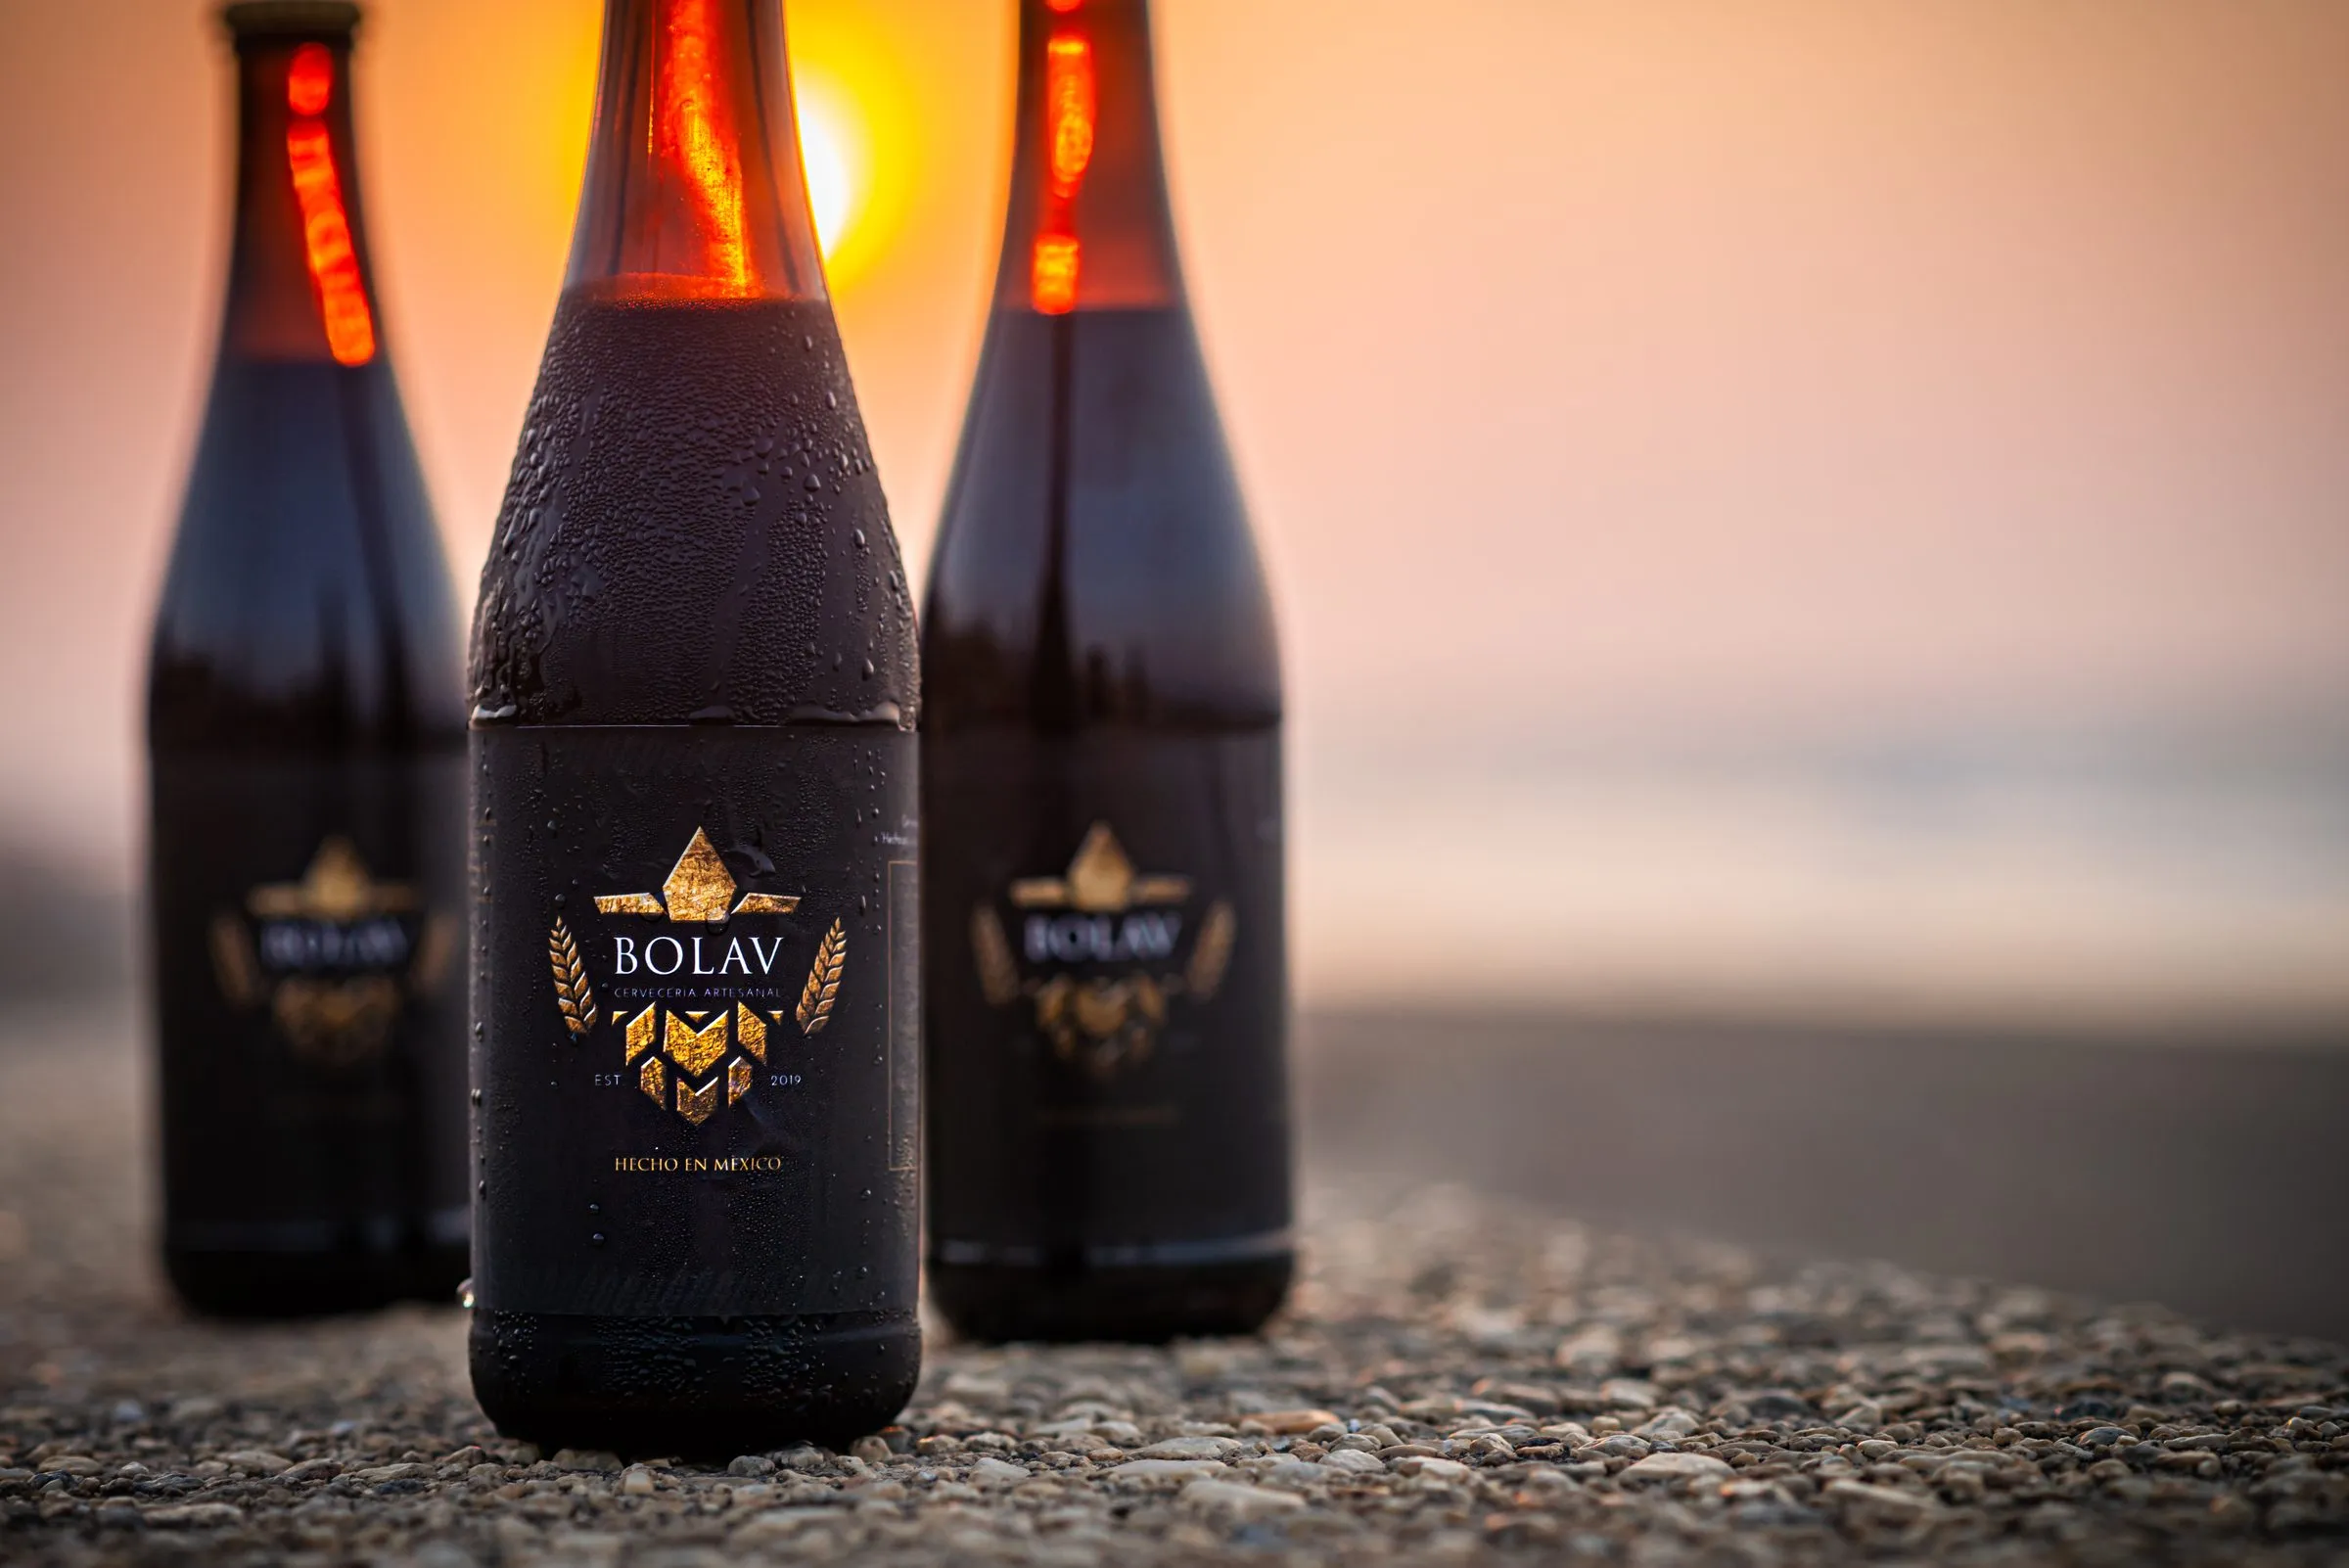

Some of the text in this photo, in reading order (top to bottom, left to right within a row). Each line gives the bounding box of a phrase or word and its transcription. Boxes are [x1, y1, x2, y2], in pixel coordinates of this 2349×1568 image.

[613, 936, 784, 976] BOLAV
[614, 988, 781, 998] CERVECERIA ARTESANAL
[594, 1074, 621, 1086] EST
[770, 1075, 803, 1086] 2019
[615, 1157, 678, 1172] HECHO
[684, 1157, 708, 1172] EN
